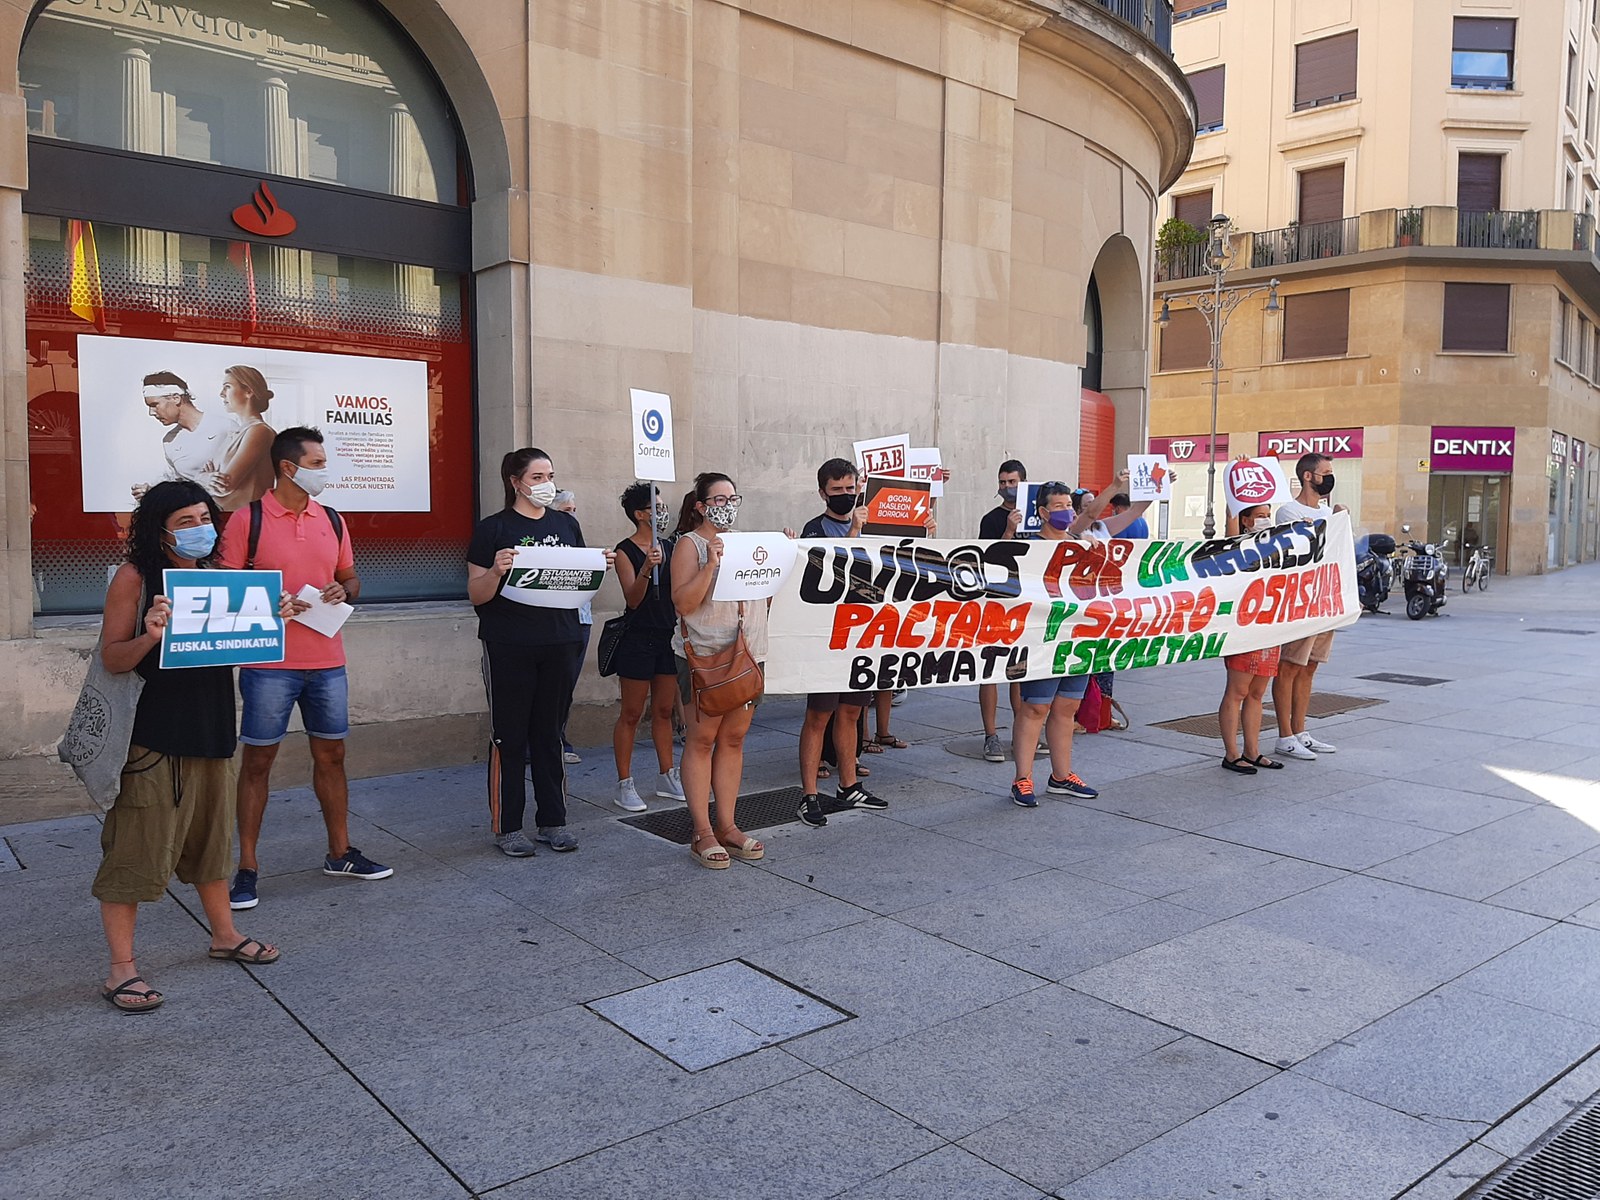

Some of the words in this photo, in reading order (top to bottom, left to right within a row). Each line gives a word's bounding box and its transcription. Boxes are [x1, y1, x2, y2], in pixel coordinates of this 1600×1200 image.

[334, 395, 392, 412] VAMOS,
[326, 410, 393, 426] FAMILIAS
[638, 443, 670, 458] Sortzen
[1267, 435, 1351, 455] DENTIX
[1433, 438, 1512, 457] DENTIX
[866, 449, 902, 472] LAB
[1133, 477, 1163, 488] SEP
[1231, 466, 1269, 487] UGT
[878, 510, 909, 519] BORROKA
[541, 569, 593, 577] ESTUDIANTES
[735, 568, 781, 580] AFAPNA
[1043, 539, 1134, 601] POR
[1138, 541, 1202, 588] UN
[172, 586, 279, 635] ELA
[829, 600, 1033, 650] PACTADO
[1043, 601, 1078, 643] Y
[1070, 586, 1216, 639] SEGURO
[1237, 562, 1345, 627] OSASUNA
[170, 640, 214, 652] EUSKAL
[215, 638, 278, 650] SINDIKATUA
[849, 646, 1028, 690] BERMATU
